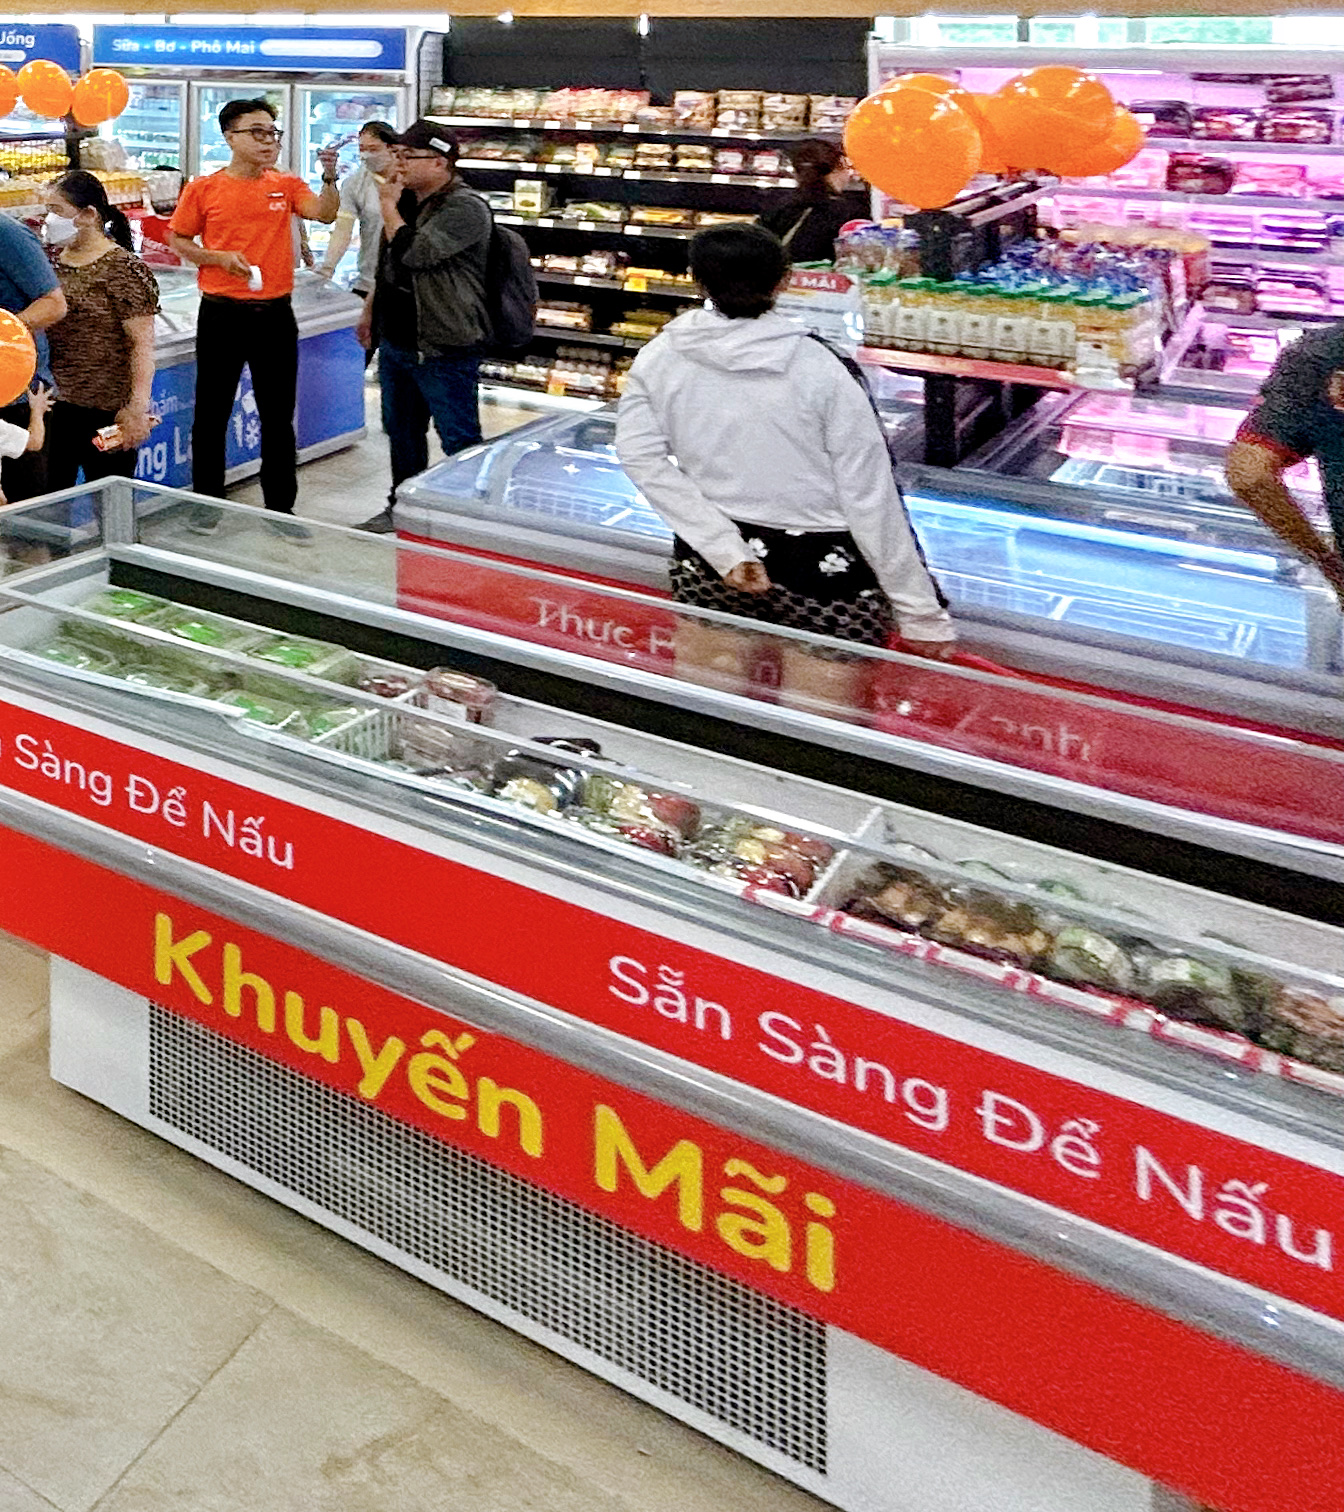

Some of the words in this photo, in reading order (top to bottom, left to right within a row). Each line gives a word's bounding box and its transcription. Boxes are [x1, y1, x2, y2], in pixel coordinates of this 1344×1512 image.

[113, 39, 140, 52] Sữa
[191, 39, 222, 54] Phô
[226, 40, 256, 54] Mai
[14, 734, 113, 807] Sàng
[124, 773, 188, 828] Để
[202, 800, 295, 870] Nấu
[152, 912, 543, 1159] Khuyến
[594, 1103, 837, 1292] Mãi
[608, 954, 731, 1042] Sẵn
[757, 1010, 949, 1132] Sàng
[977, 1087, 1104, 1180] Để
[1134, 1145, 1334, 1274] Nấu
